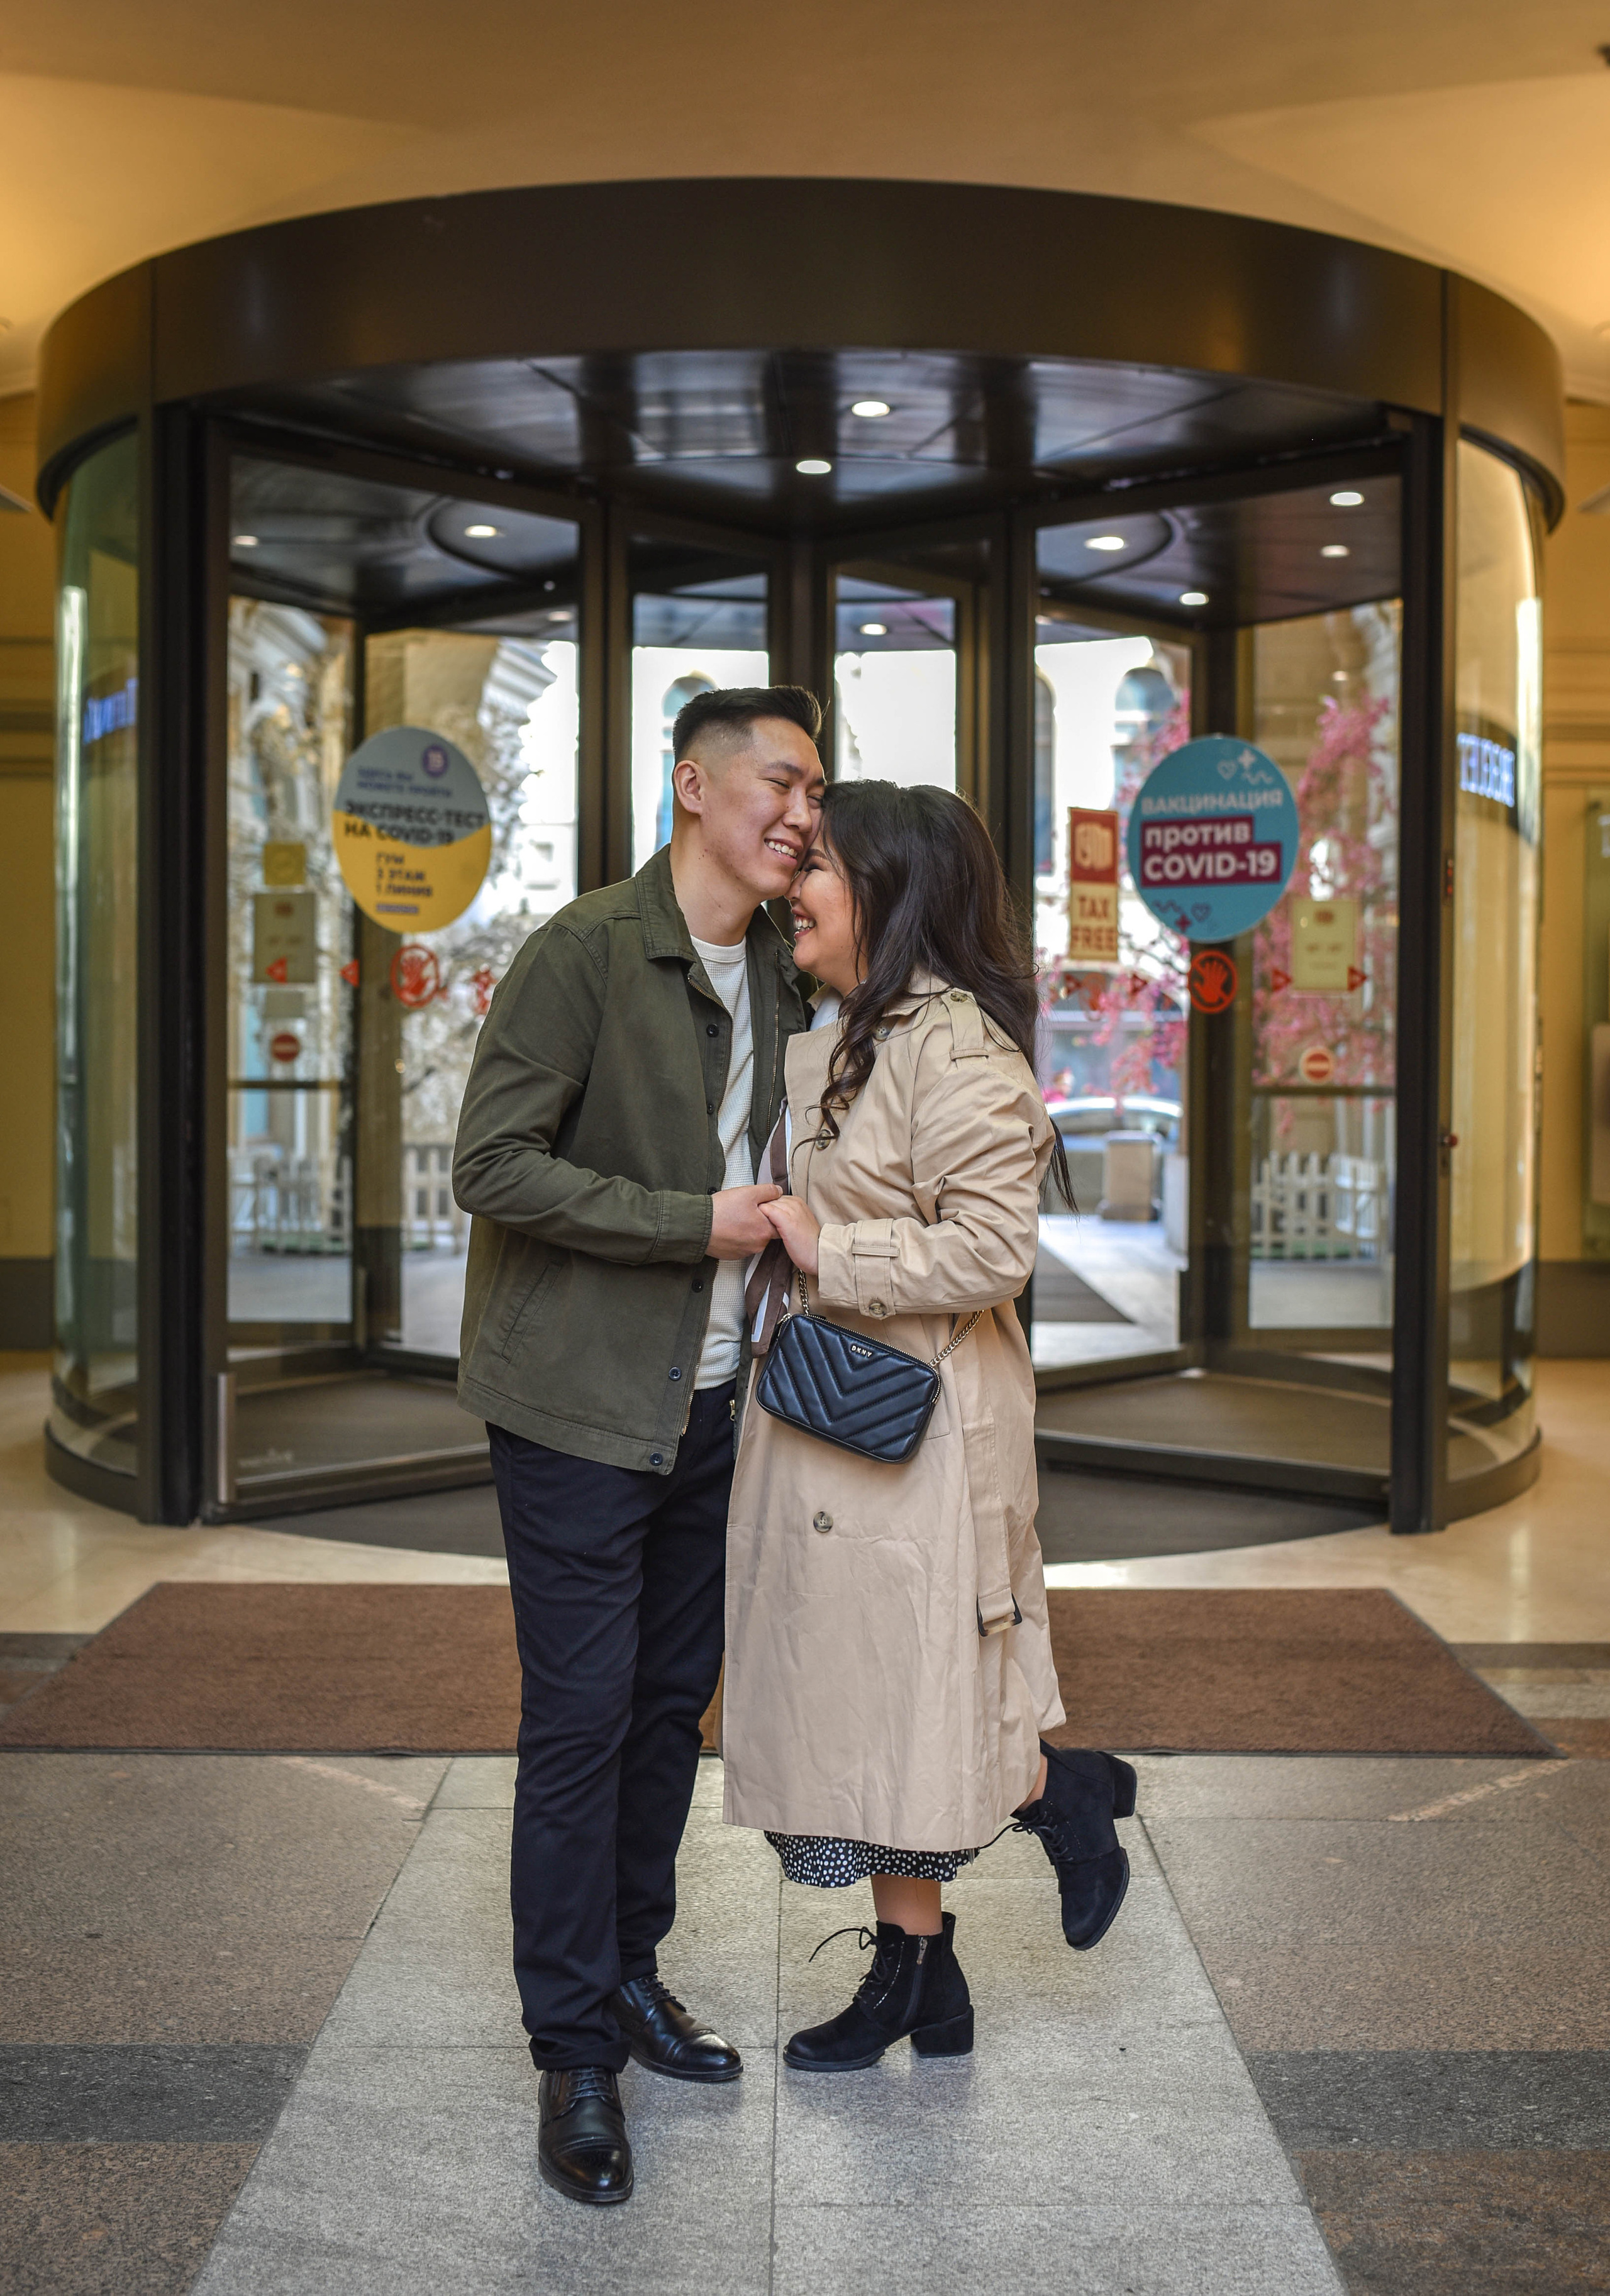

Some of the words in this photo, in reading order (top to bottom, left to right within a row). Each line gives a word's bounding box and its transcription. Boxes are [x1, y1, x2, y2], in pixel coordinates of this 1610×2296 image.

[1141, 790, 1283, 815] ВАКЦИНАЦИЯ
[344, 821, 371, 839] НА
[1145, 821, 1251, 853] против
[389, 868, 426, 882] ЭТАЖ
[1144, 849, 1277, 880] COVID-19
[1077, 895, 1109, 919] TAX
[1071, 926, 1116, 951] FREE
[851, 1345, 872, 1357] DKNY
